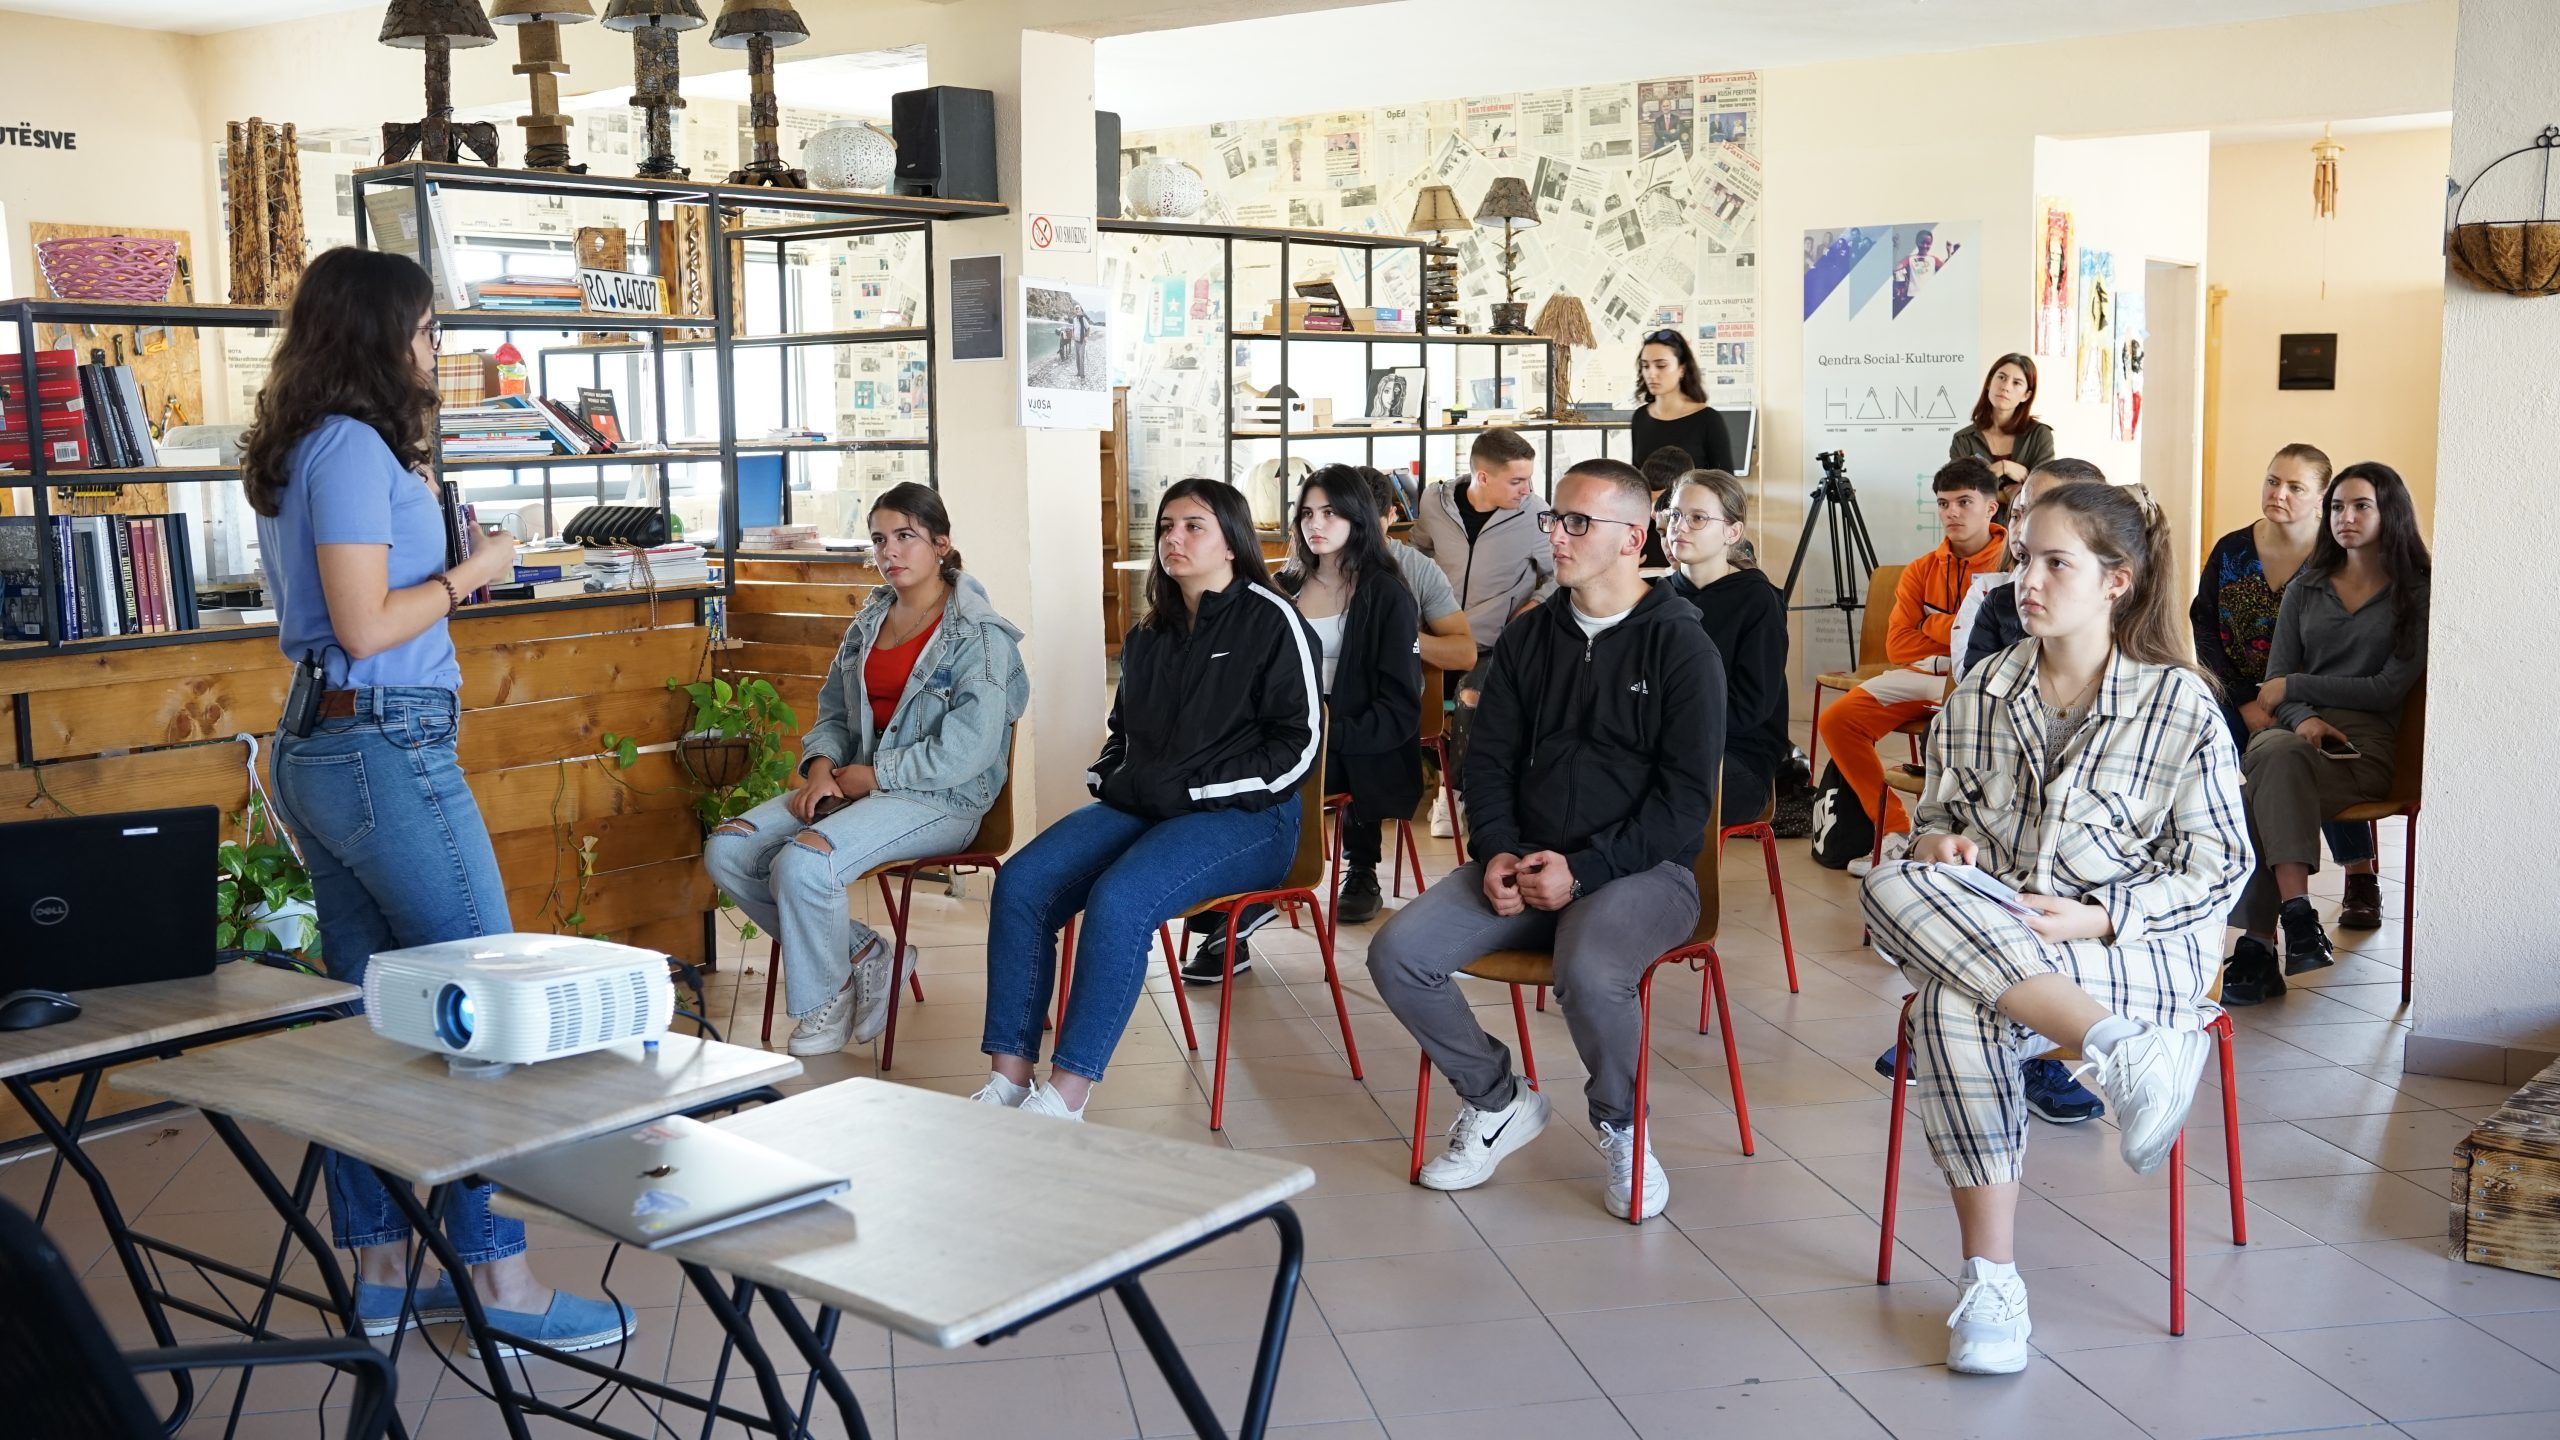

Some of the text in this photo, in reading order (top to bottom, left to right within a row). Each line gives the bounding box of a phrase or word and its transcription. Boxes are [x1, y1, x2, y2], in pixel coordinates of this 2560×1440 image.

[1386, 109, 1406, 120] OpEd
[1054, 225, 1087, 244] NO SMOKING
[1818, 352, 1965, 367] Qendra Social-Kulturore
[1027, 398, 1052, 410] VJOSA
[136, 552, 148, 597] MONOGRAPHIE
[148, 552, 159, 596] MONOGRAPHIE
[35, 906, 65, 917] DELL
